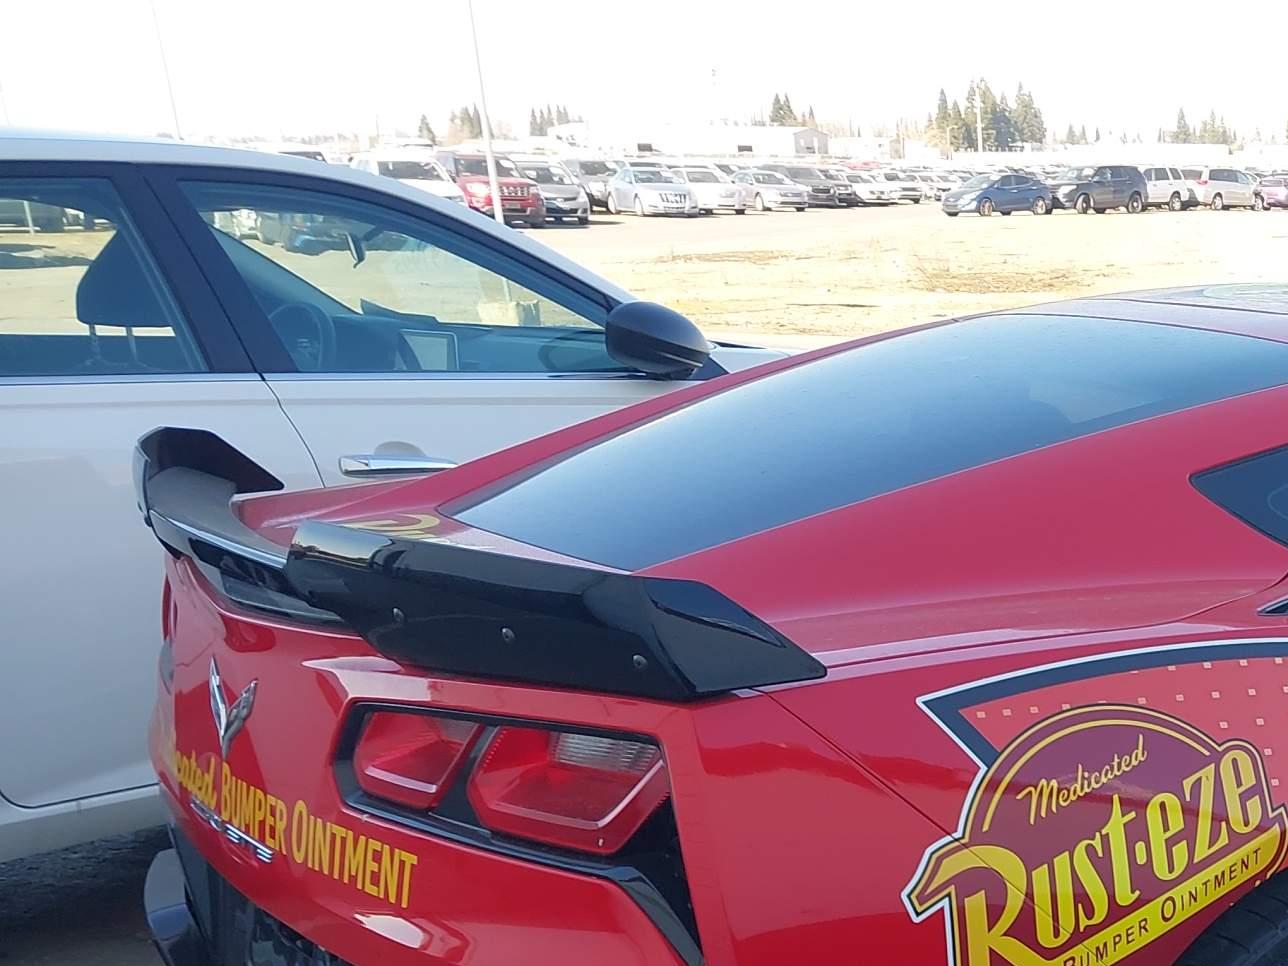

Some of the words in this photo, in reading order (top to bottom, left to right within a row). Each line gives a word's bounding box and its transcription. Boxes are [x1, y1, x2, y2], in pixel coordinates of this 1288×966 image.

[1016, 734, 1148, 825] Medicated
[221, 761, 288, 856] BUMPER
[291, 799, 418, 909] OINTMENT
[1160, 846, 1263, 923] OINTMENT
